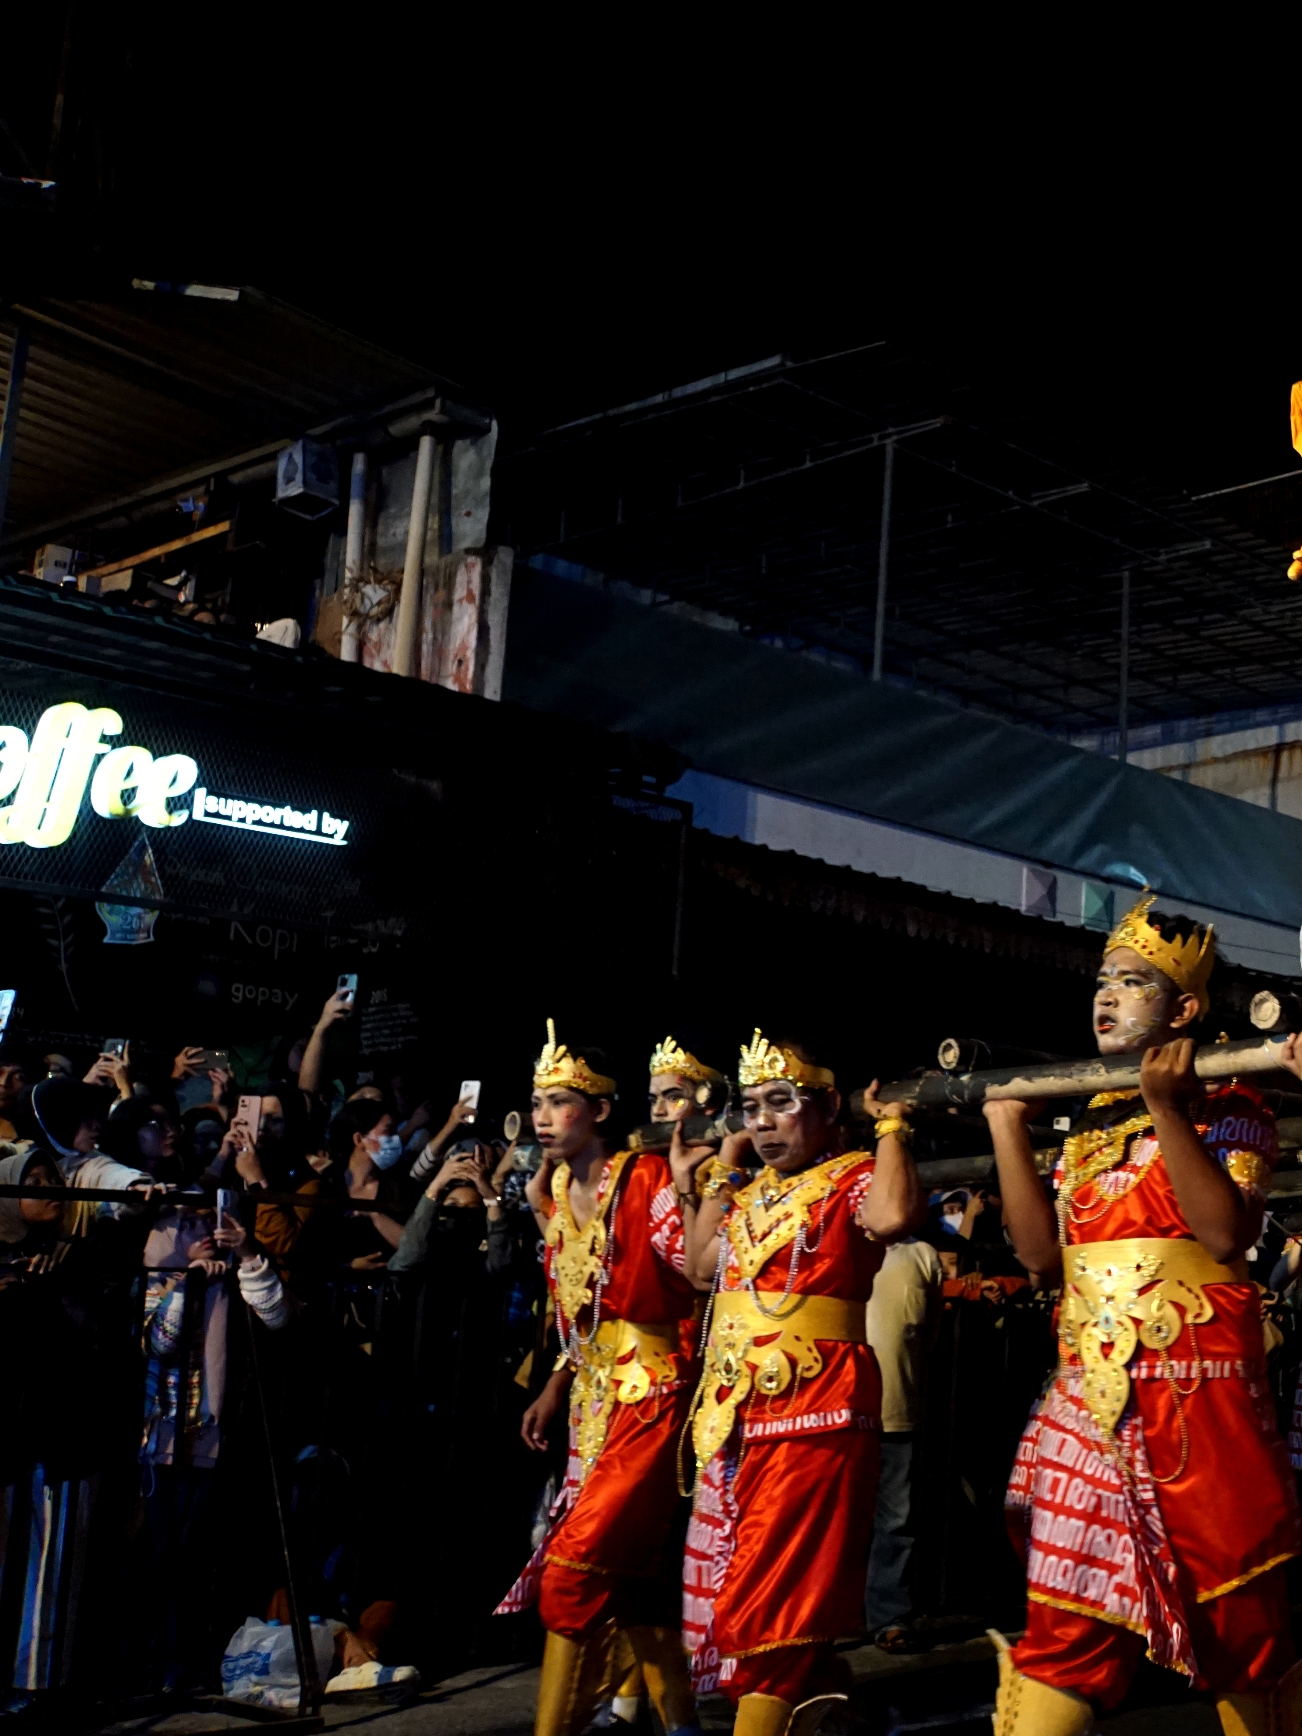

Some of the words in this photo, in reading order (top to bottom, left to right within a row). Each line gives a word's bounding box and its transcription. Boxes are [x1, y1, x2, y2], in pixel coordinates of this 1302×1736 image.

[204, 794, 319, 832] supported
[321, 811, 350, 840] by
[230, 981, 299, 1012] gopay
